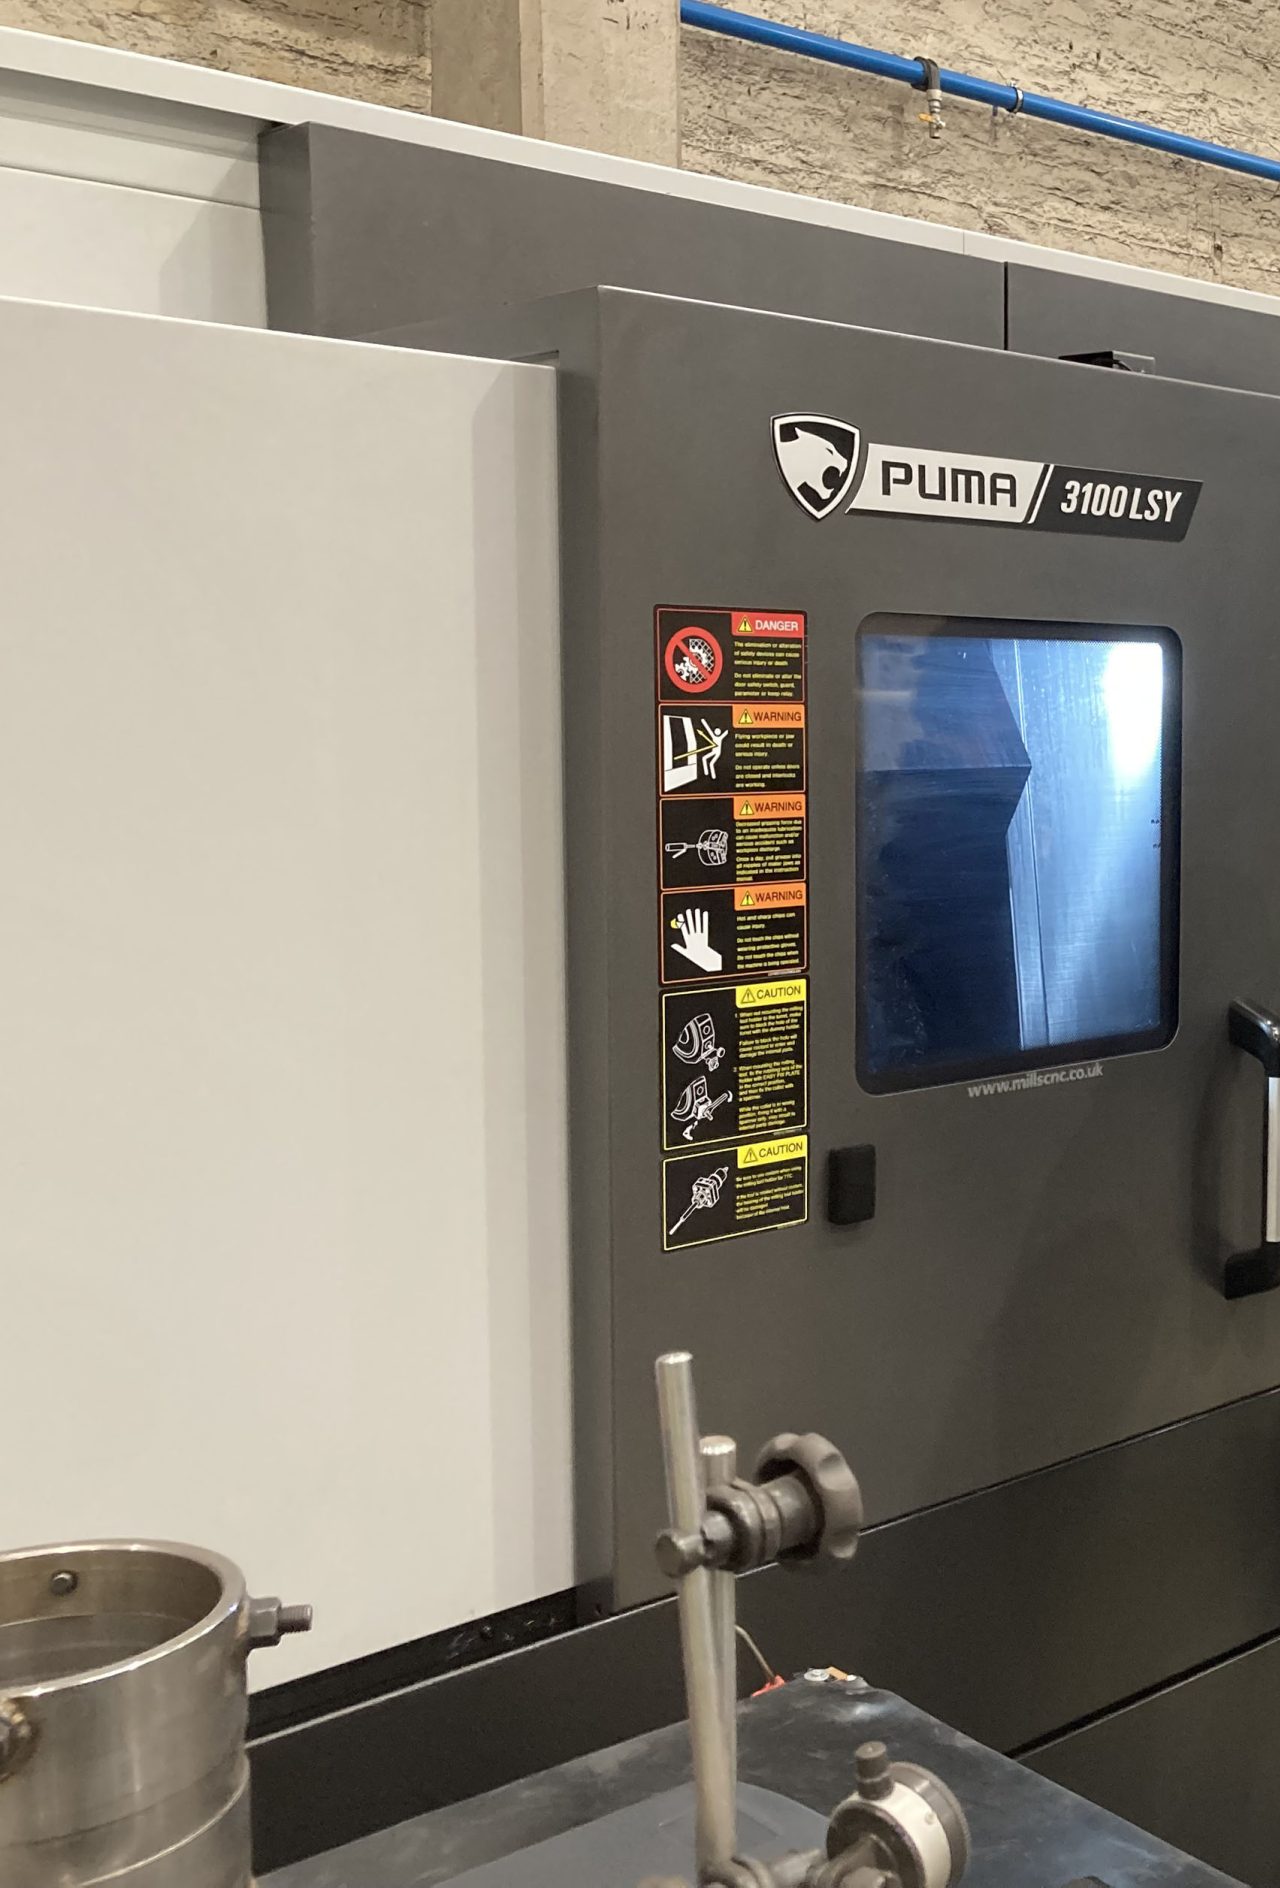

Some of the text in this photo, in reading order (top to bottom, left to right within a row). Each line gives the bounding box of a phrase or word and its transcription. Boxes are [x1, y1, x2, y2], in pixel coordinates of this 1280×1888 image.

[881, 460, 1182, 523] PUMA 3100LSY
[755, 619, 799, 631] DANGER
[753, 711, 802, 722] WARNING
[754, 801, 802, 813] WARNING
[755, 889, 803, 903] WARNING
[756, 985, 801, 1000] CAUTION
[967, 1063, 1104, 1098] www.millscnc.co.uk
[758, 1141, 803, 1158] CAUTION
